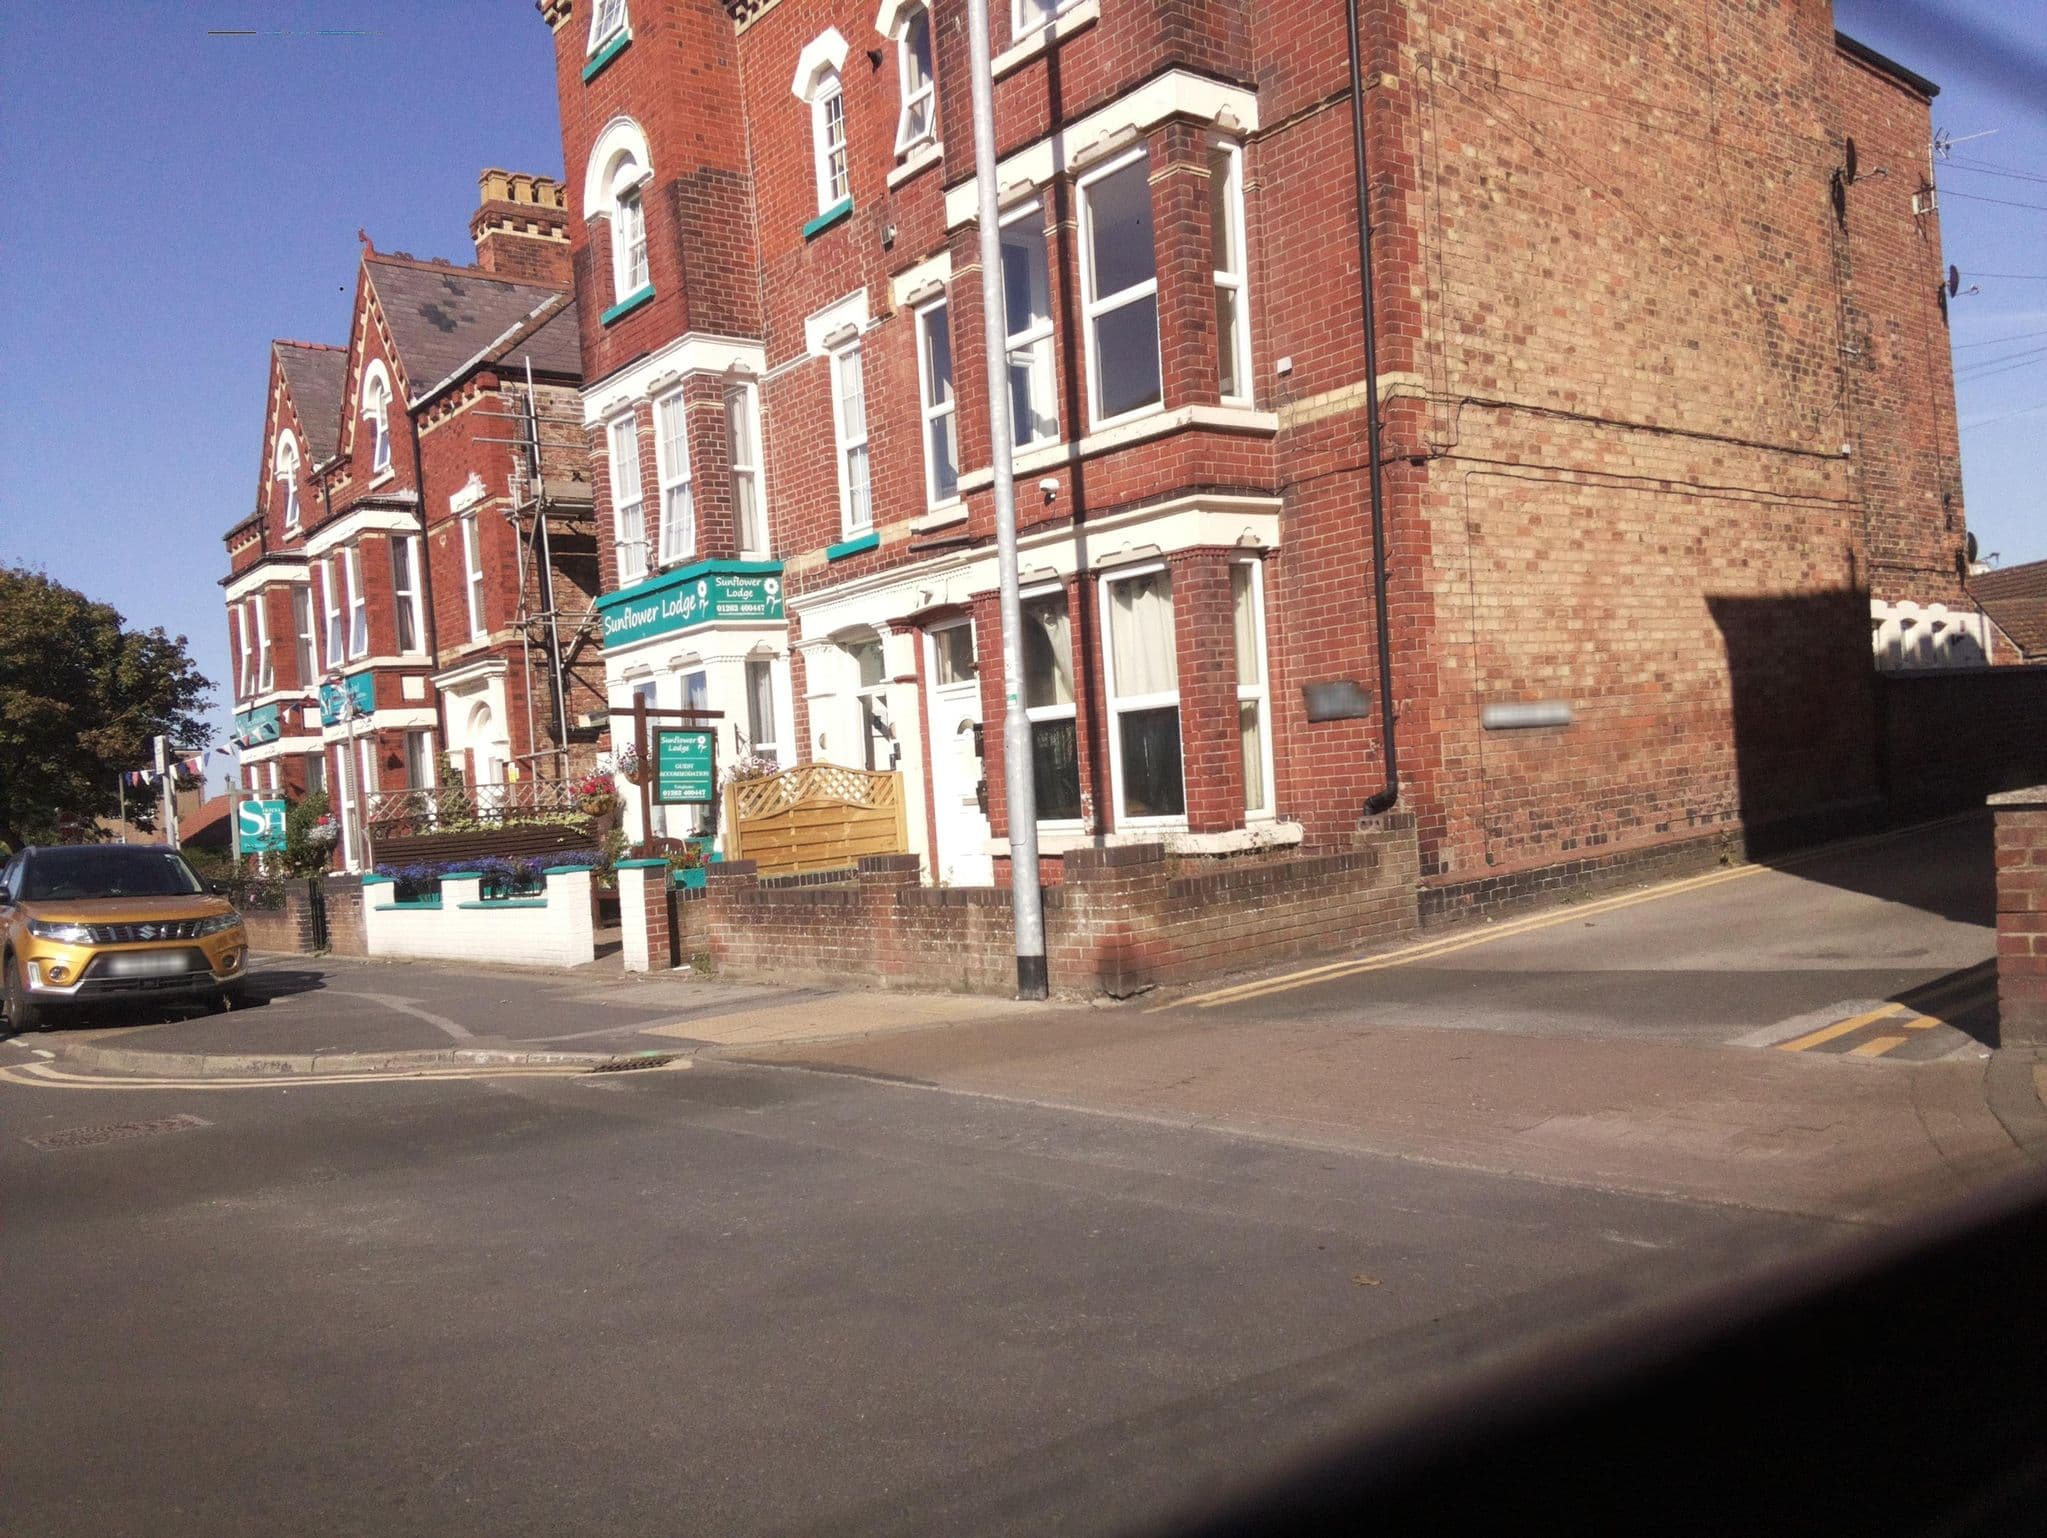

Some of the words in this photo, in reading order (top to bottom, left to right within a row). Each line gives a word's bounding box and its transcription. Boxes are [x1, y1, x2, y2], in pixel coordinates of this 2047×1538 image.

[715, 576, 762, 587] Sunflower
[726, 588, 754, 600] Lodge
[604, 606, 659, 635] Sunflower
[662, 591, 696, 620] Lodge
[660, 736, 696, 744] Sunflower
[668, 745, 690, 753] Lodge
